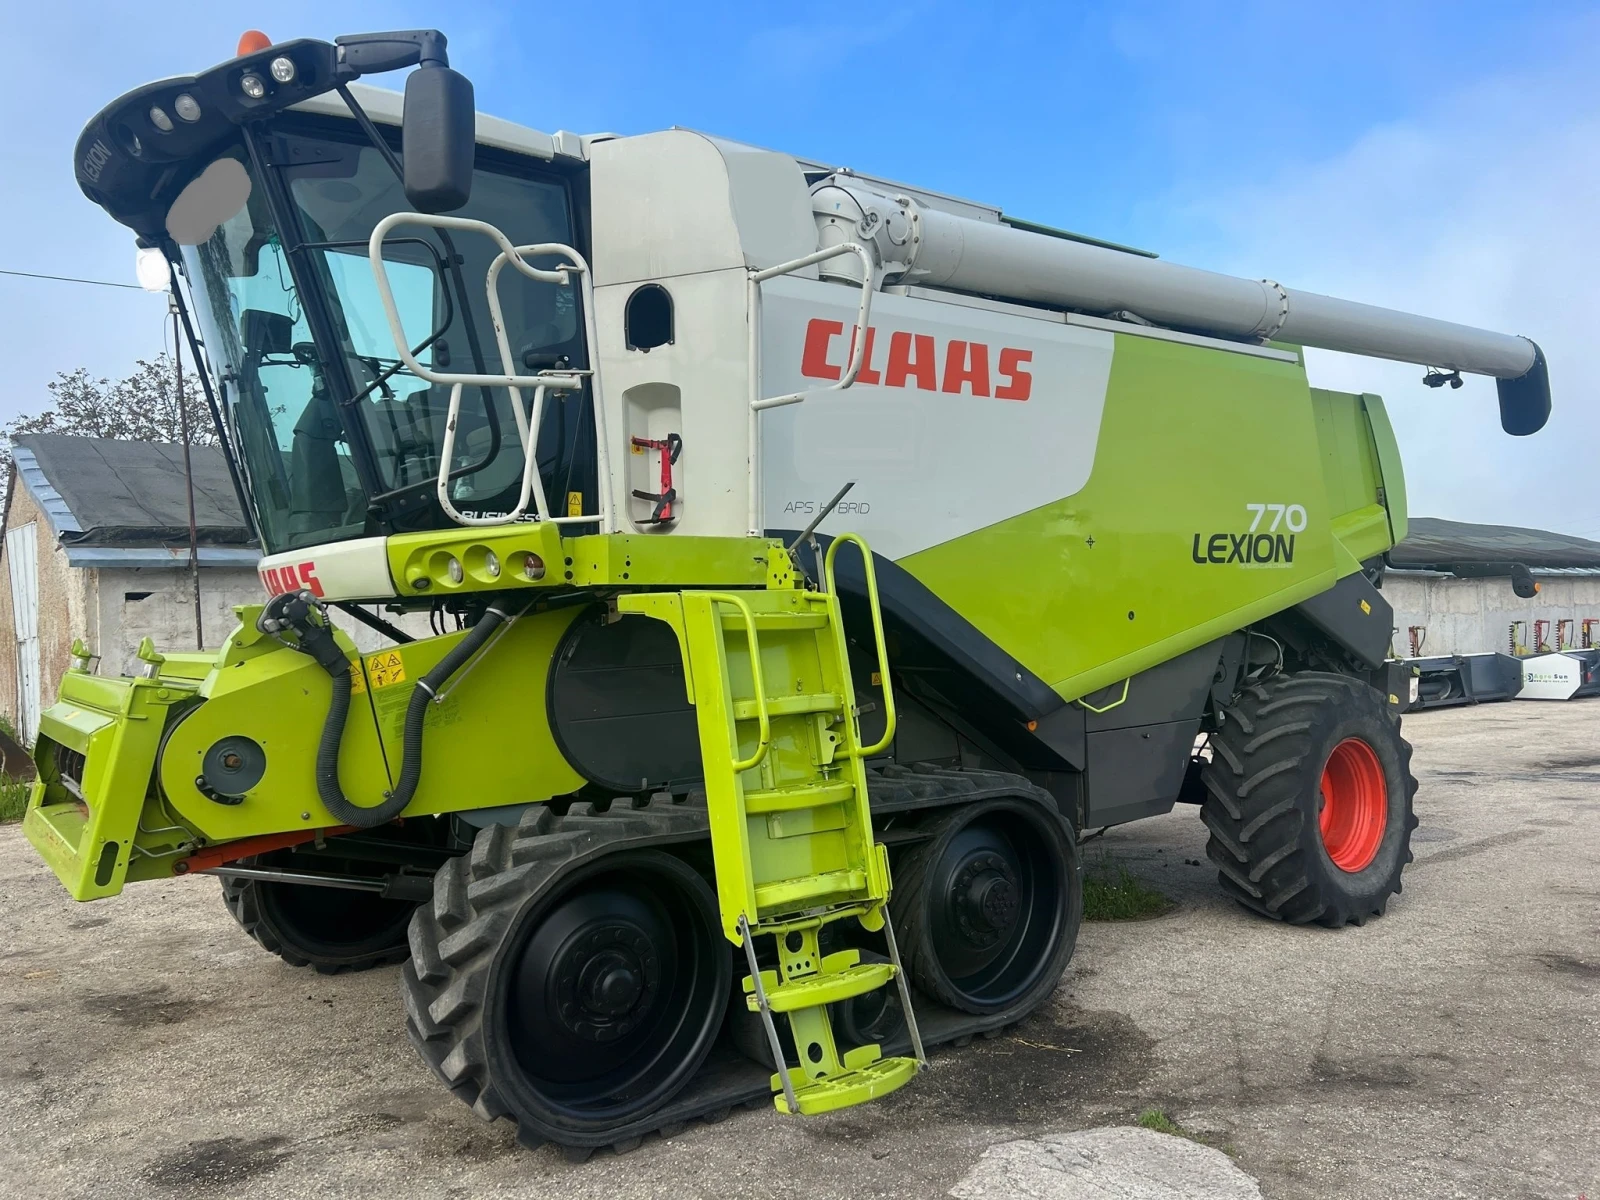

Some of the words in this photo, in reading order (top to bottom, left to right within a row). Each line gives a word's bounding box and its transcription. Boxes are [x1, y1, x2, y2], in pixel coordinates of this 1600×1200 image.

[81, 139, 112, 182] LEXION
[801, 318, 1033, 401] CLAAS
[783, 501, 814, 514] APS
[1246, 503, 1308, 533] 770
[1192, 533, 1296, 564] LEXION
